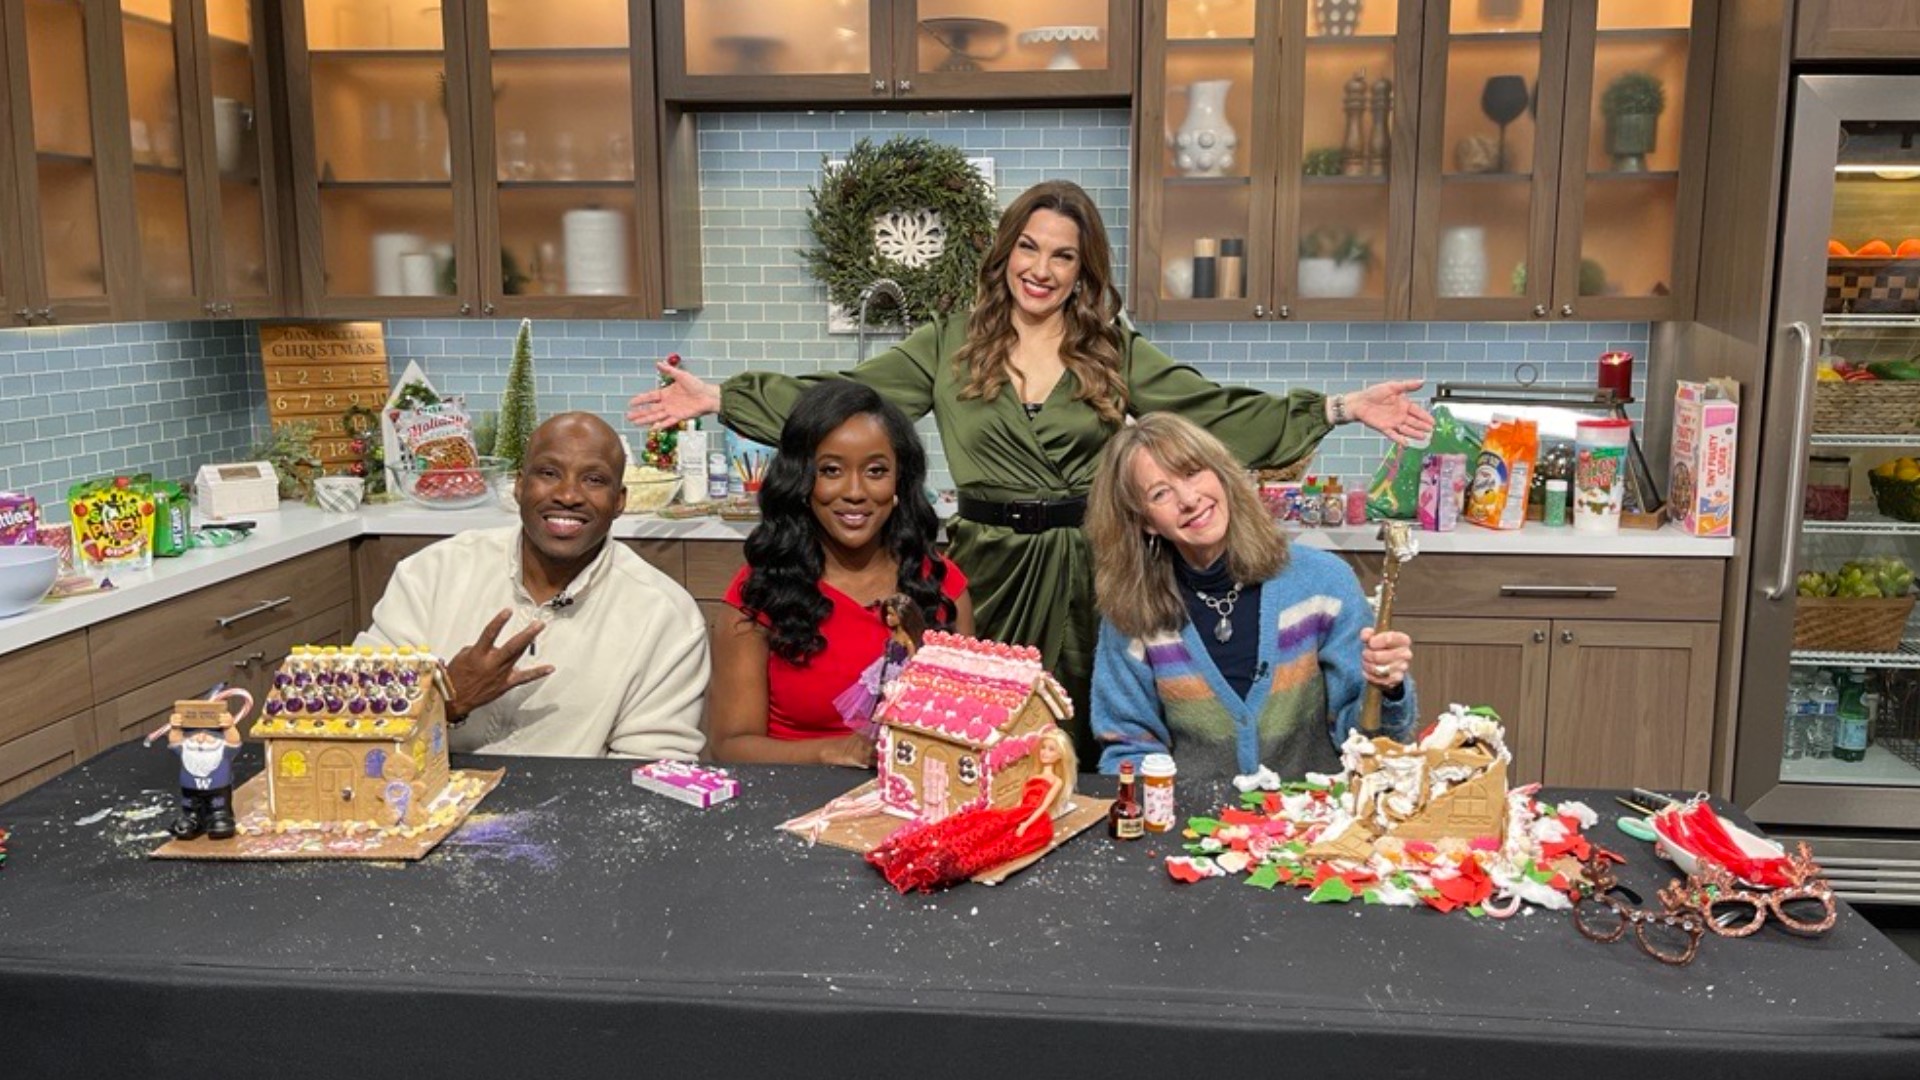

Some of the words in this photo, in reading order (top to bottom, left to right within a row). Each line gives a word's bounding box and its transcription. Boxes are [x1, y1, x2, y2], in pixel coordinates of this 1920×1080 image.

[272, 343, 376, 360] CHRISTMAS
[275, 371, 283, 385] 1
[298, 370, 309, 385] 2
[322, 369, 334, 383] 3
[348, 368, 359, 382] 4
[371, 368, 383, 382] 5
[276, 395, 288, 410] 6
[301, 395, 311, 409] 7
[325, 393, 336, 408] 8
[349, 392, 359, 405] 9
[353, 415, 367, 431] 14
[328, 442, 348, 457] 18
[194, 778, 213, 789] W
